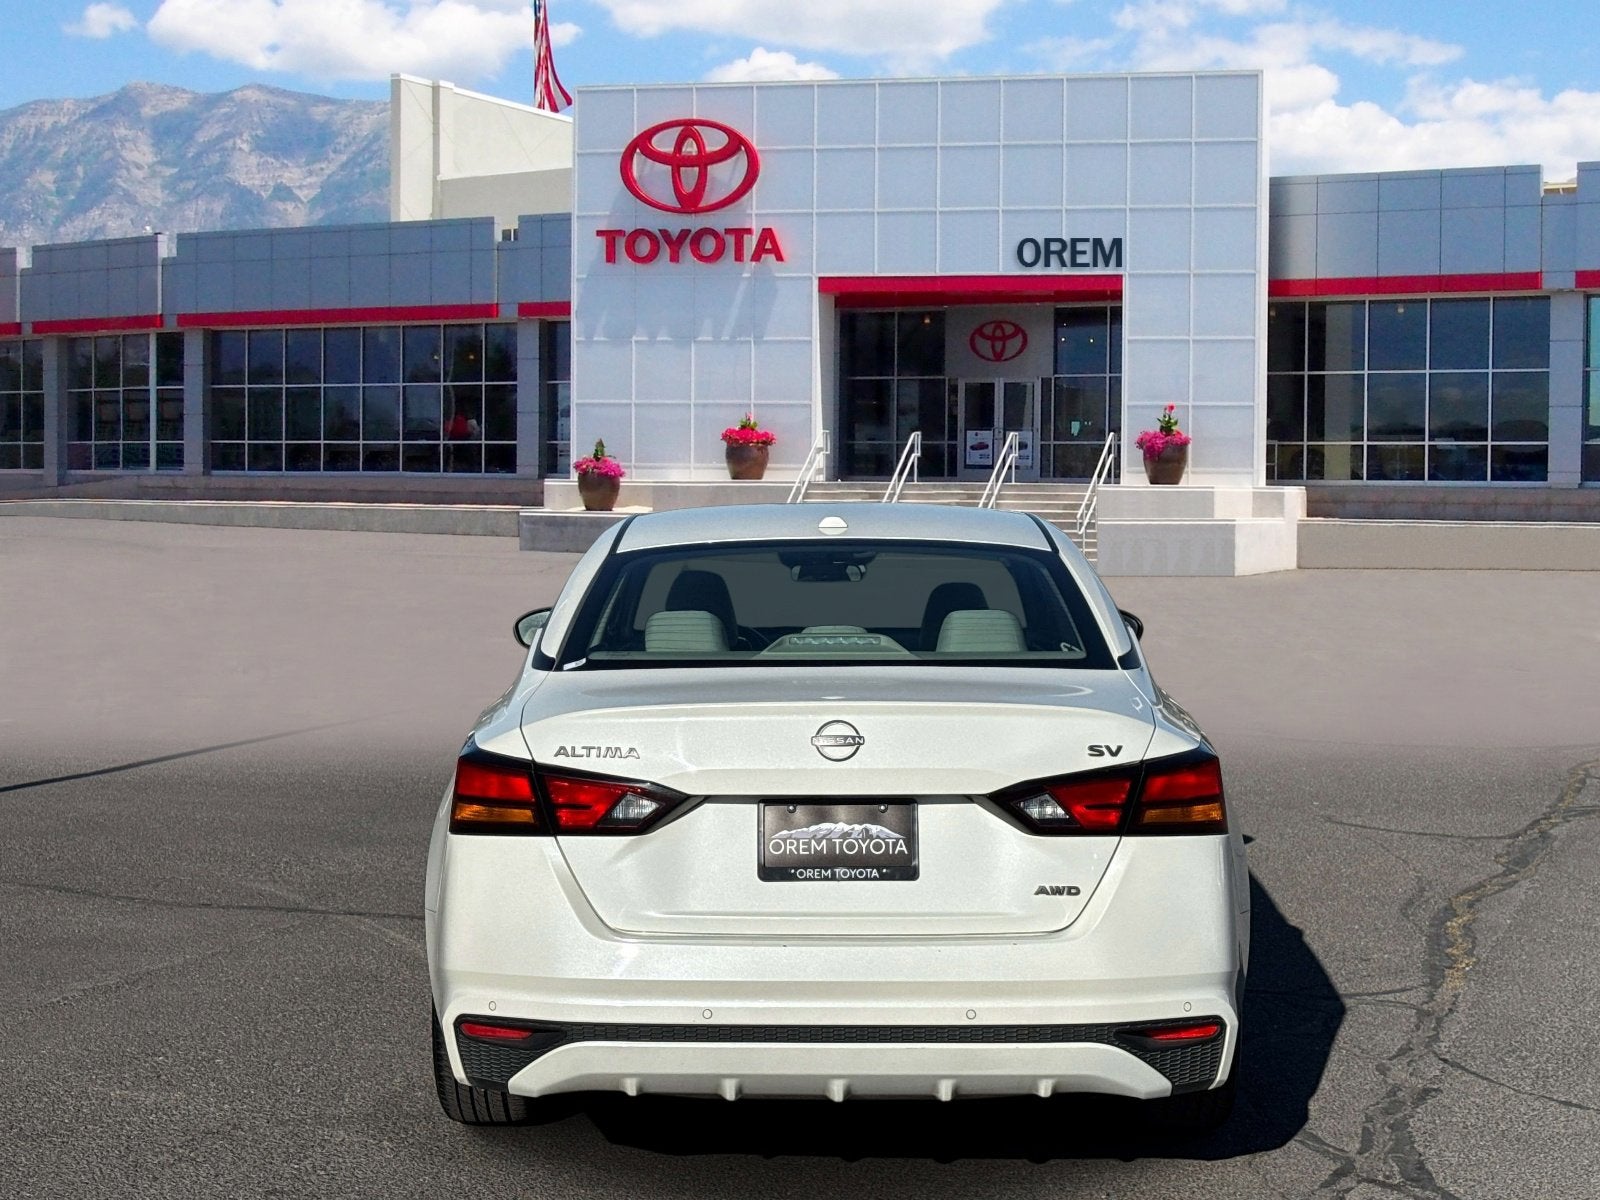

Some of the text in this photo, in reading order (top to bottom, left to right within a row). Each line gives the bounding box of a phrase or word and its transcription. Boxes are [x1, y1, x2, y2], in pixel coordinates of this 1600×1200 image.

[596, 227, 785, 264] TOYOTA
[1016, 237, 1123, 268] OREM
[812, 736, 864, 744] NISSAN
[553, 745, 641, 760] ALTIMA
[1087, 744, 1123, 758] SV
[769, 838, 909, 855] OREM TOYOTA
[796, 868, 880, 879] OREM TOYOTA
[1033, 885, 1081, 896] AWD
